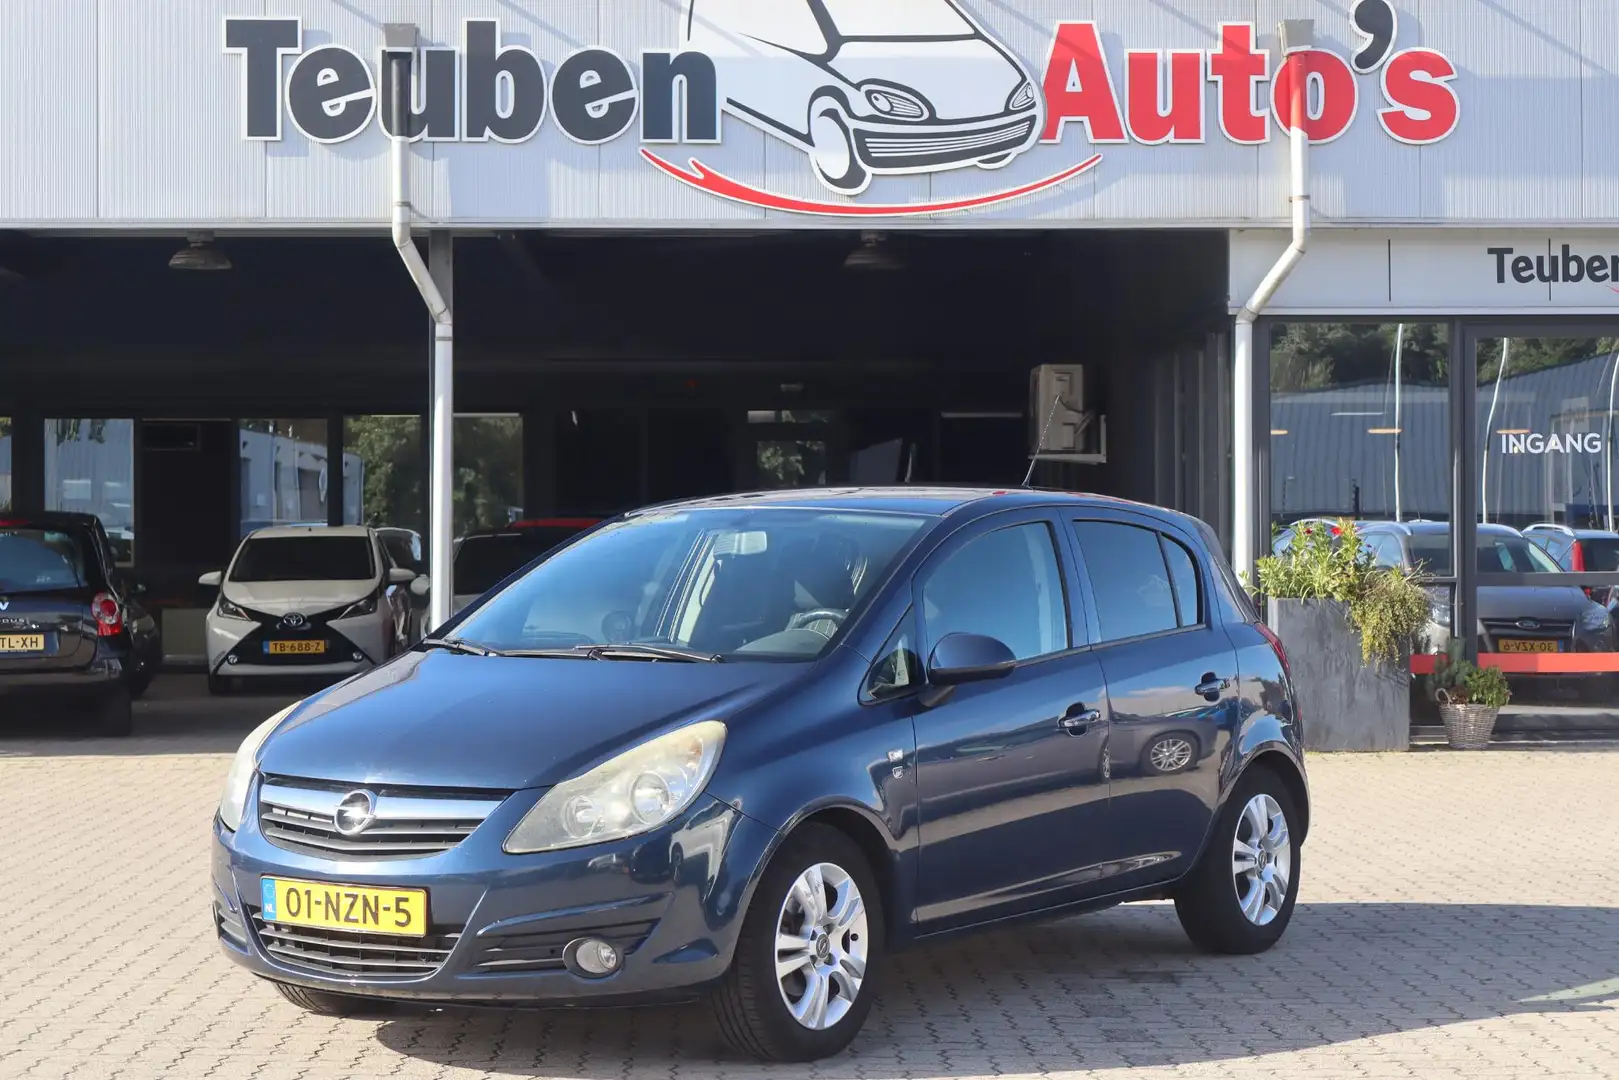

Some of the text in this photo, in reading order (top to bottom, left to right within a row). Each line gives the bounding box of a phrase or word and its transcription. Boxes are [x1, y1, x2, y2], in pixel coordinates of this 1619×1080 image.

[223, 0, 1460, 144] Teuben Auto's
[1501, 433, 1602, 454] INGANG
[286, 887, 412, 928] 01-NZN-5
